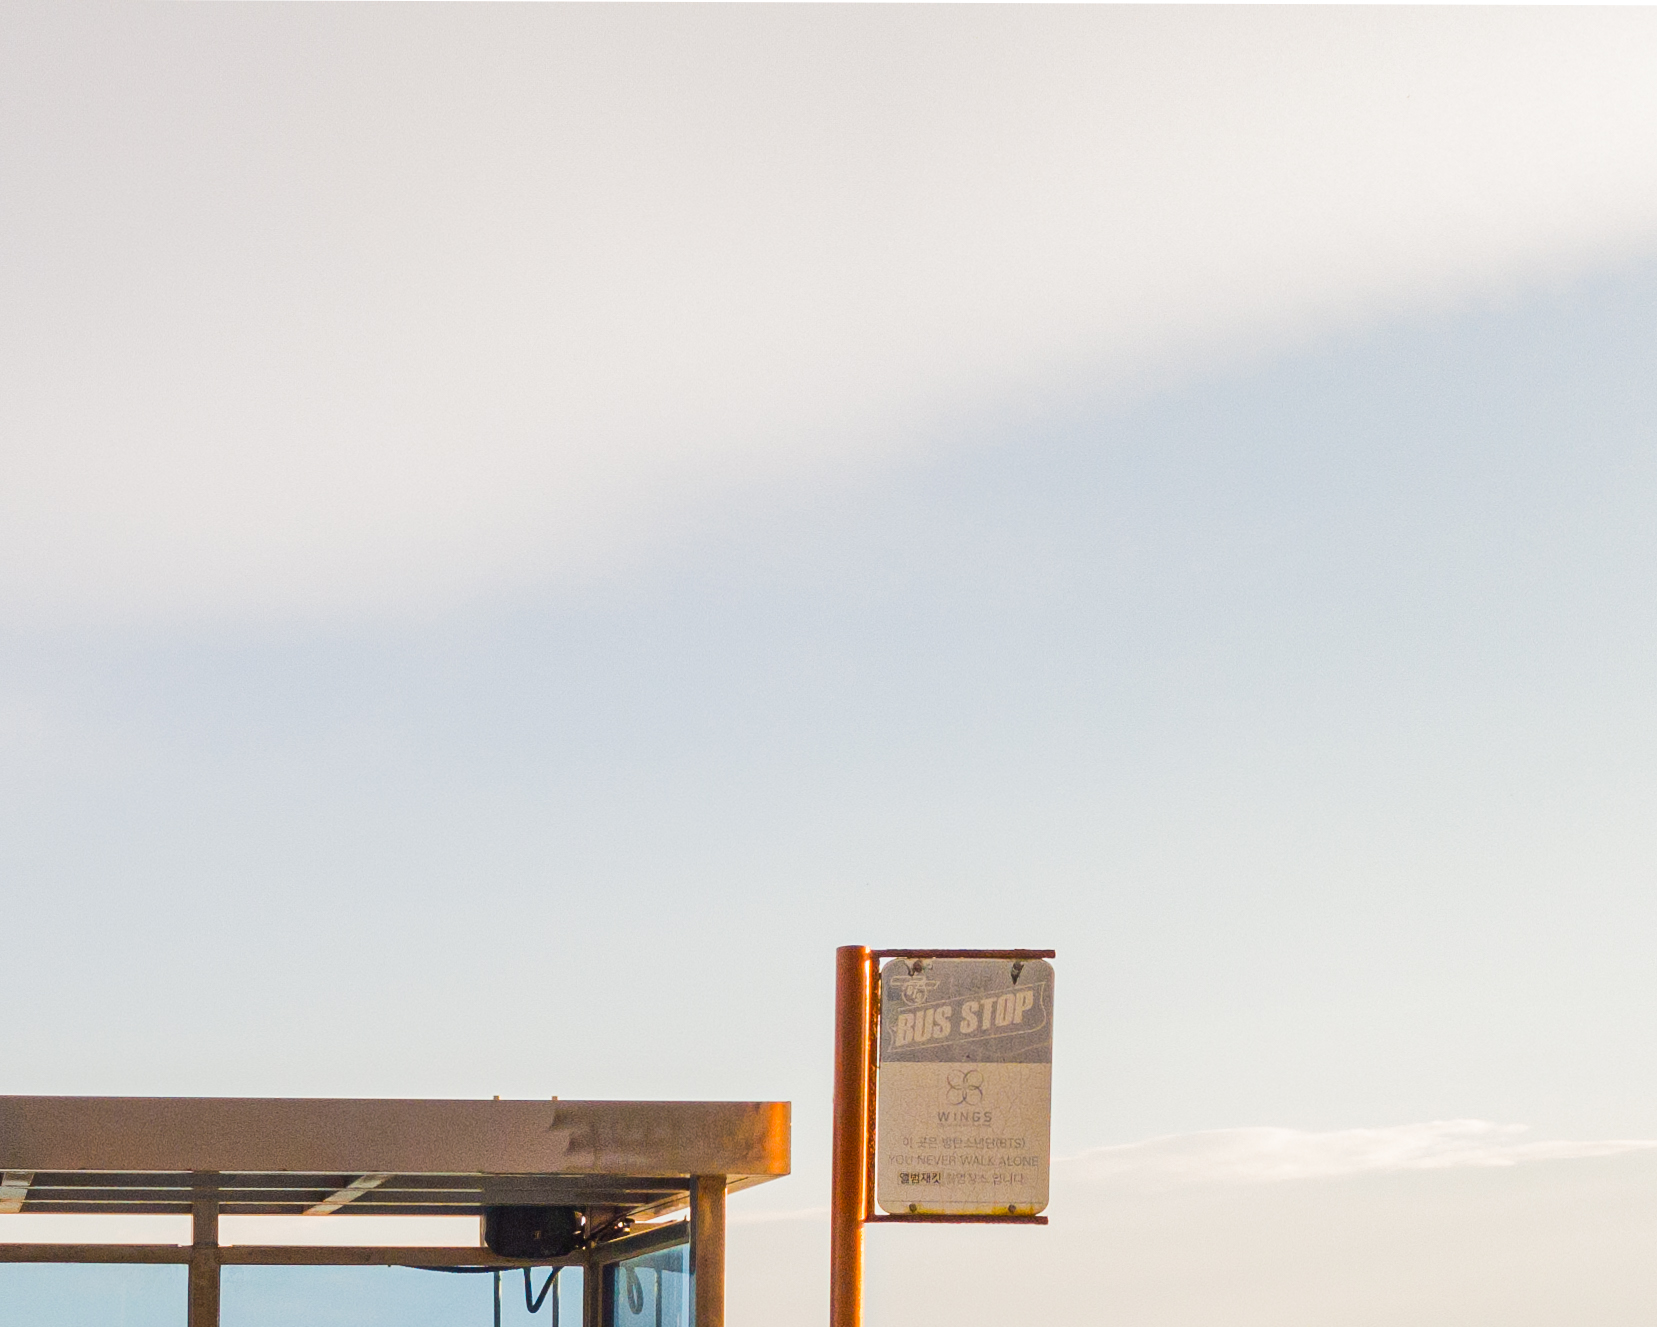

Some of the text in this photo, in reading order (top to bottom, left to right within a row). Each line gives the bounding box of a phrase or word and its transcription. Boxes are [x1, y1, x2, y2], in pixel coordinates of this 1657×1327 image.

[894, 990, 1034, 1047] BUS STOP
[937, 1111, 992, 1123] WINGS
[903, 1137, 913, 1150] 이
[888, 1154, 1039, 1168] YOU NEVER WALK ALONE
